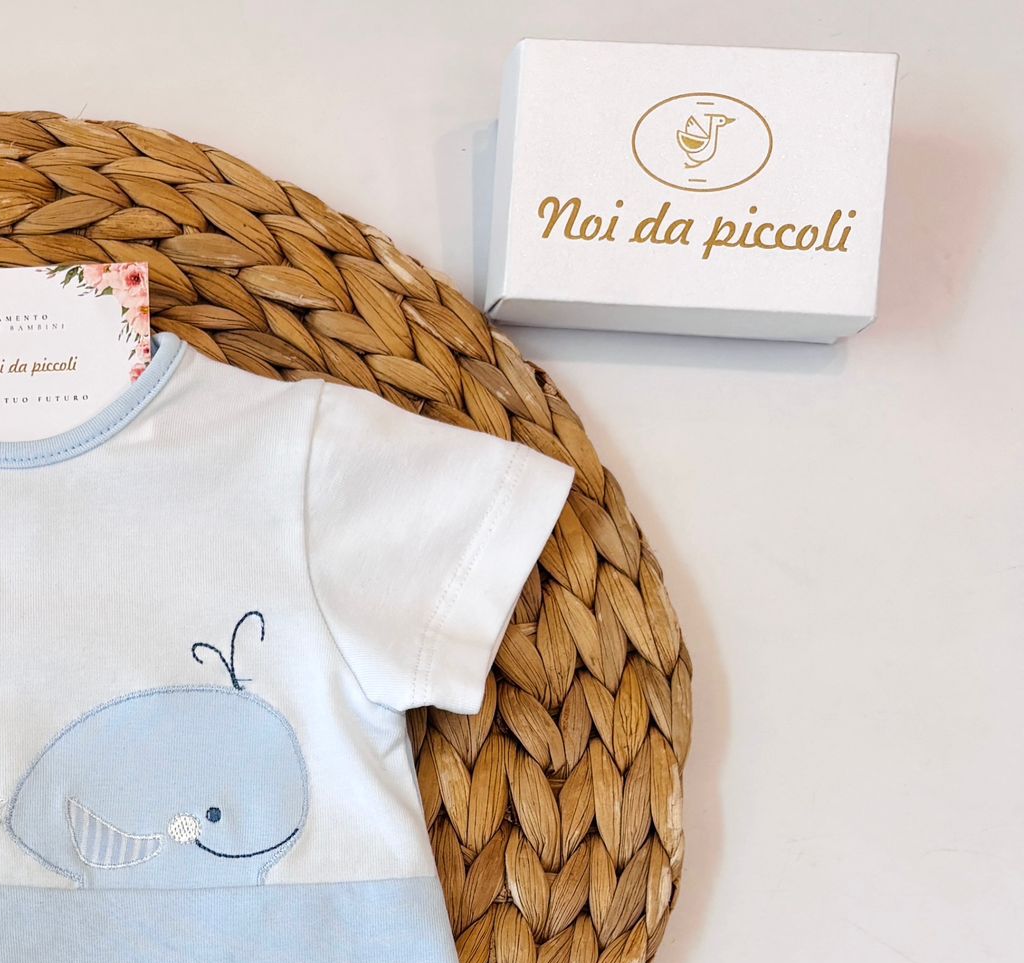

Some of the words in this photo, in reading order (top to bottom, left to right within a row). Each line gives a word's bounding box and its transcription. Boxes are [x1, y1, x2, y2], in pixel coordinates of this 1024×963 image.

[537, 196, 624, 242] Noi
[628, 202, 695, 246] da
[703, 205, 858, 260] piccoli
[9, 323, 66, 332] BAMBINI
[7, 358, 29, 374] da
[31, 356, 78, 377] piccoli
[4, 396, 29, 404] TUO
[37, 394, 90, 403] FUTURO
